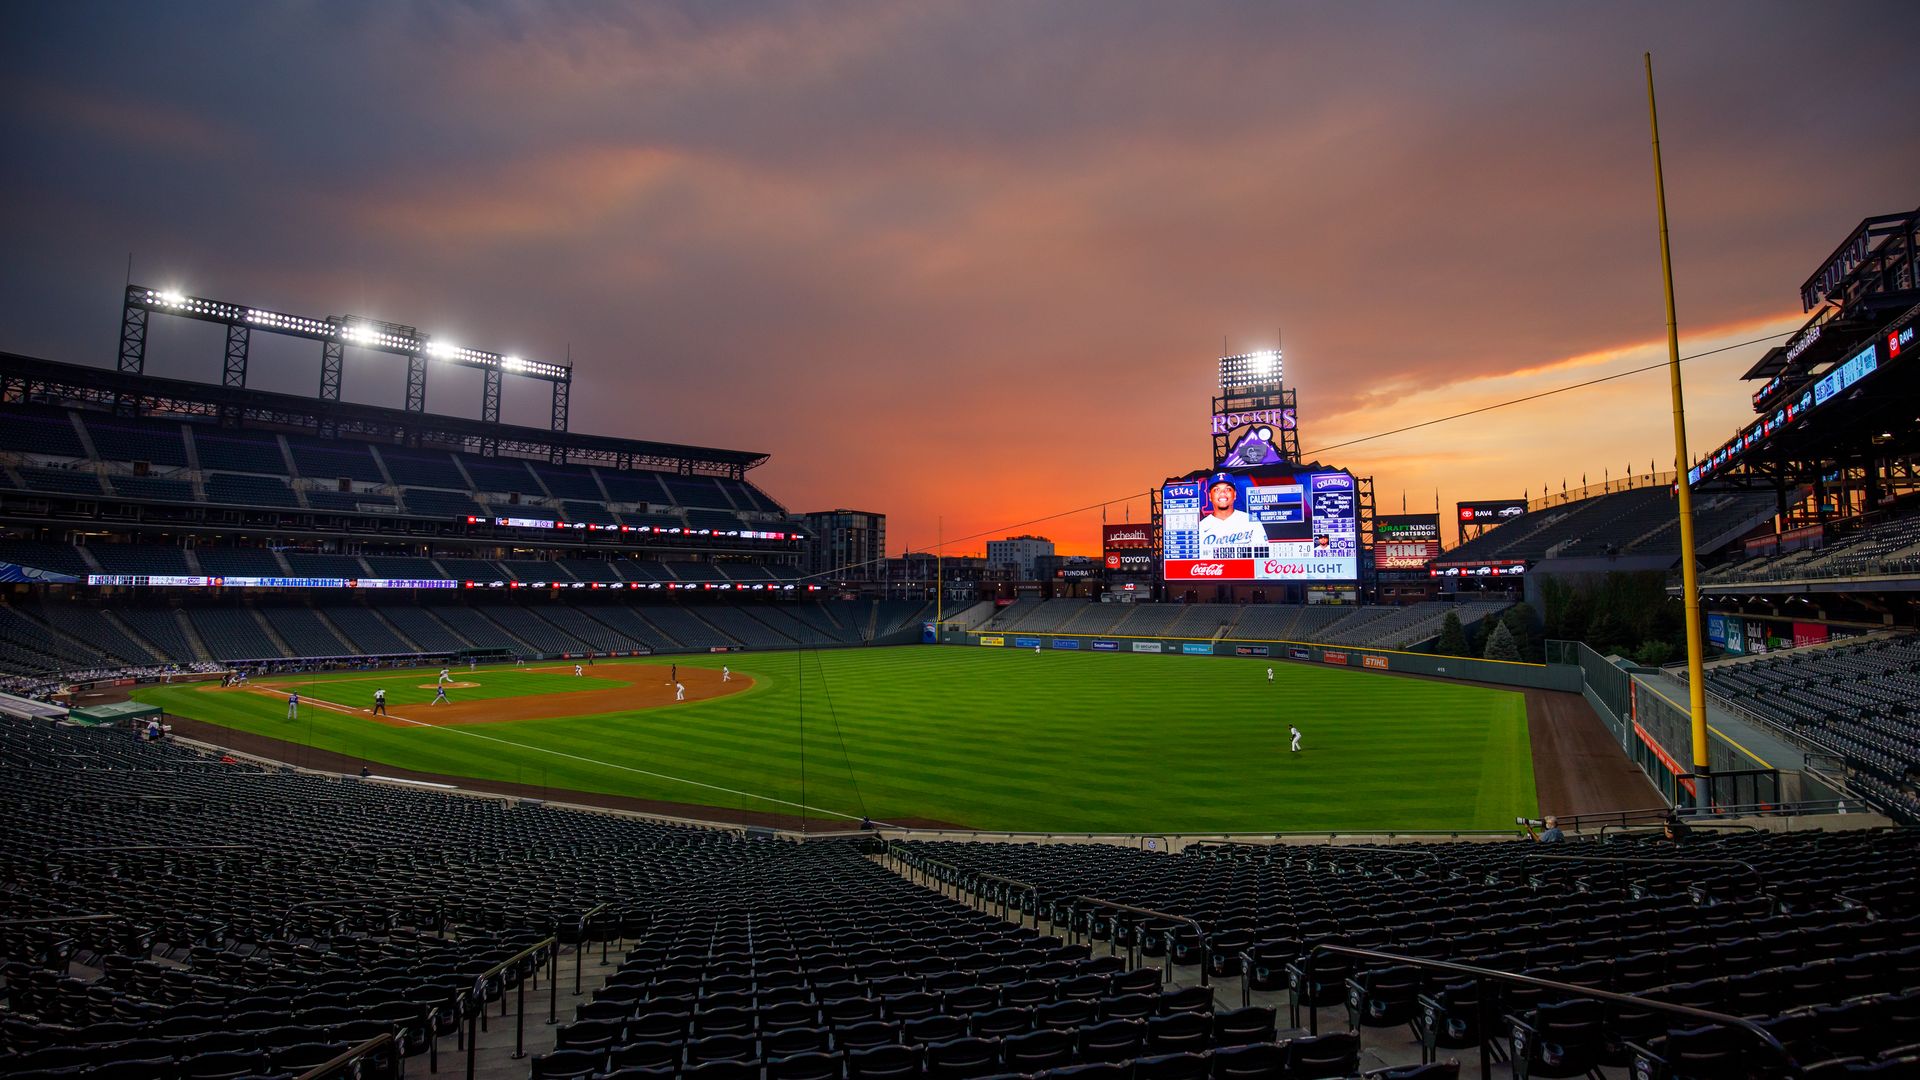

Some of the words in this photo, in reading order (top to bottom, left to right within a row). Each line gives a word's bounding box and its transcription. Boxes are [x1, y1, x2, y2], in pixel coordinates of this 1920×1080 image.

[1899, 327, 1914, 345] RAV4
[1211, 408, 1297, 436] ROCKIES
[1316, 478, 1350, 489] COLORADO
[1168, 487, 1194, 497] TEXAS
[1249, 495, 1278, 504] CALHOUN
[1378, 524, 1437, 533] DRAFTKINGS
[1110, 530, 1145, 541] uchealth
[1386, 544, 1427, 557] KING
[1264, 559, 1304, 574] Coors
[1306, 563, 1343, 574] LIGHT
[1365, 658, 1387, 667] STIHL
